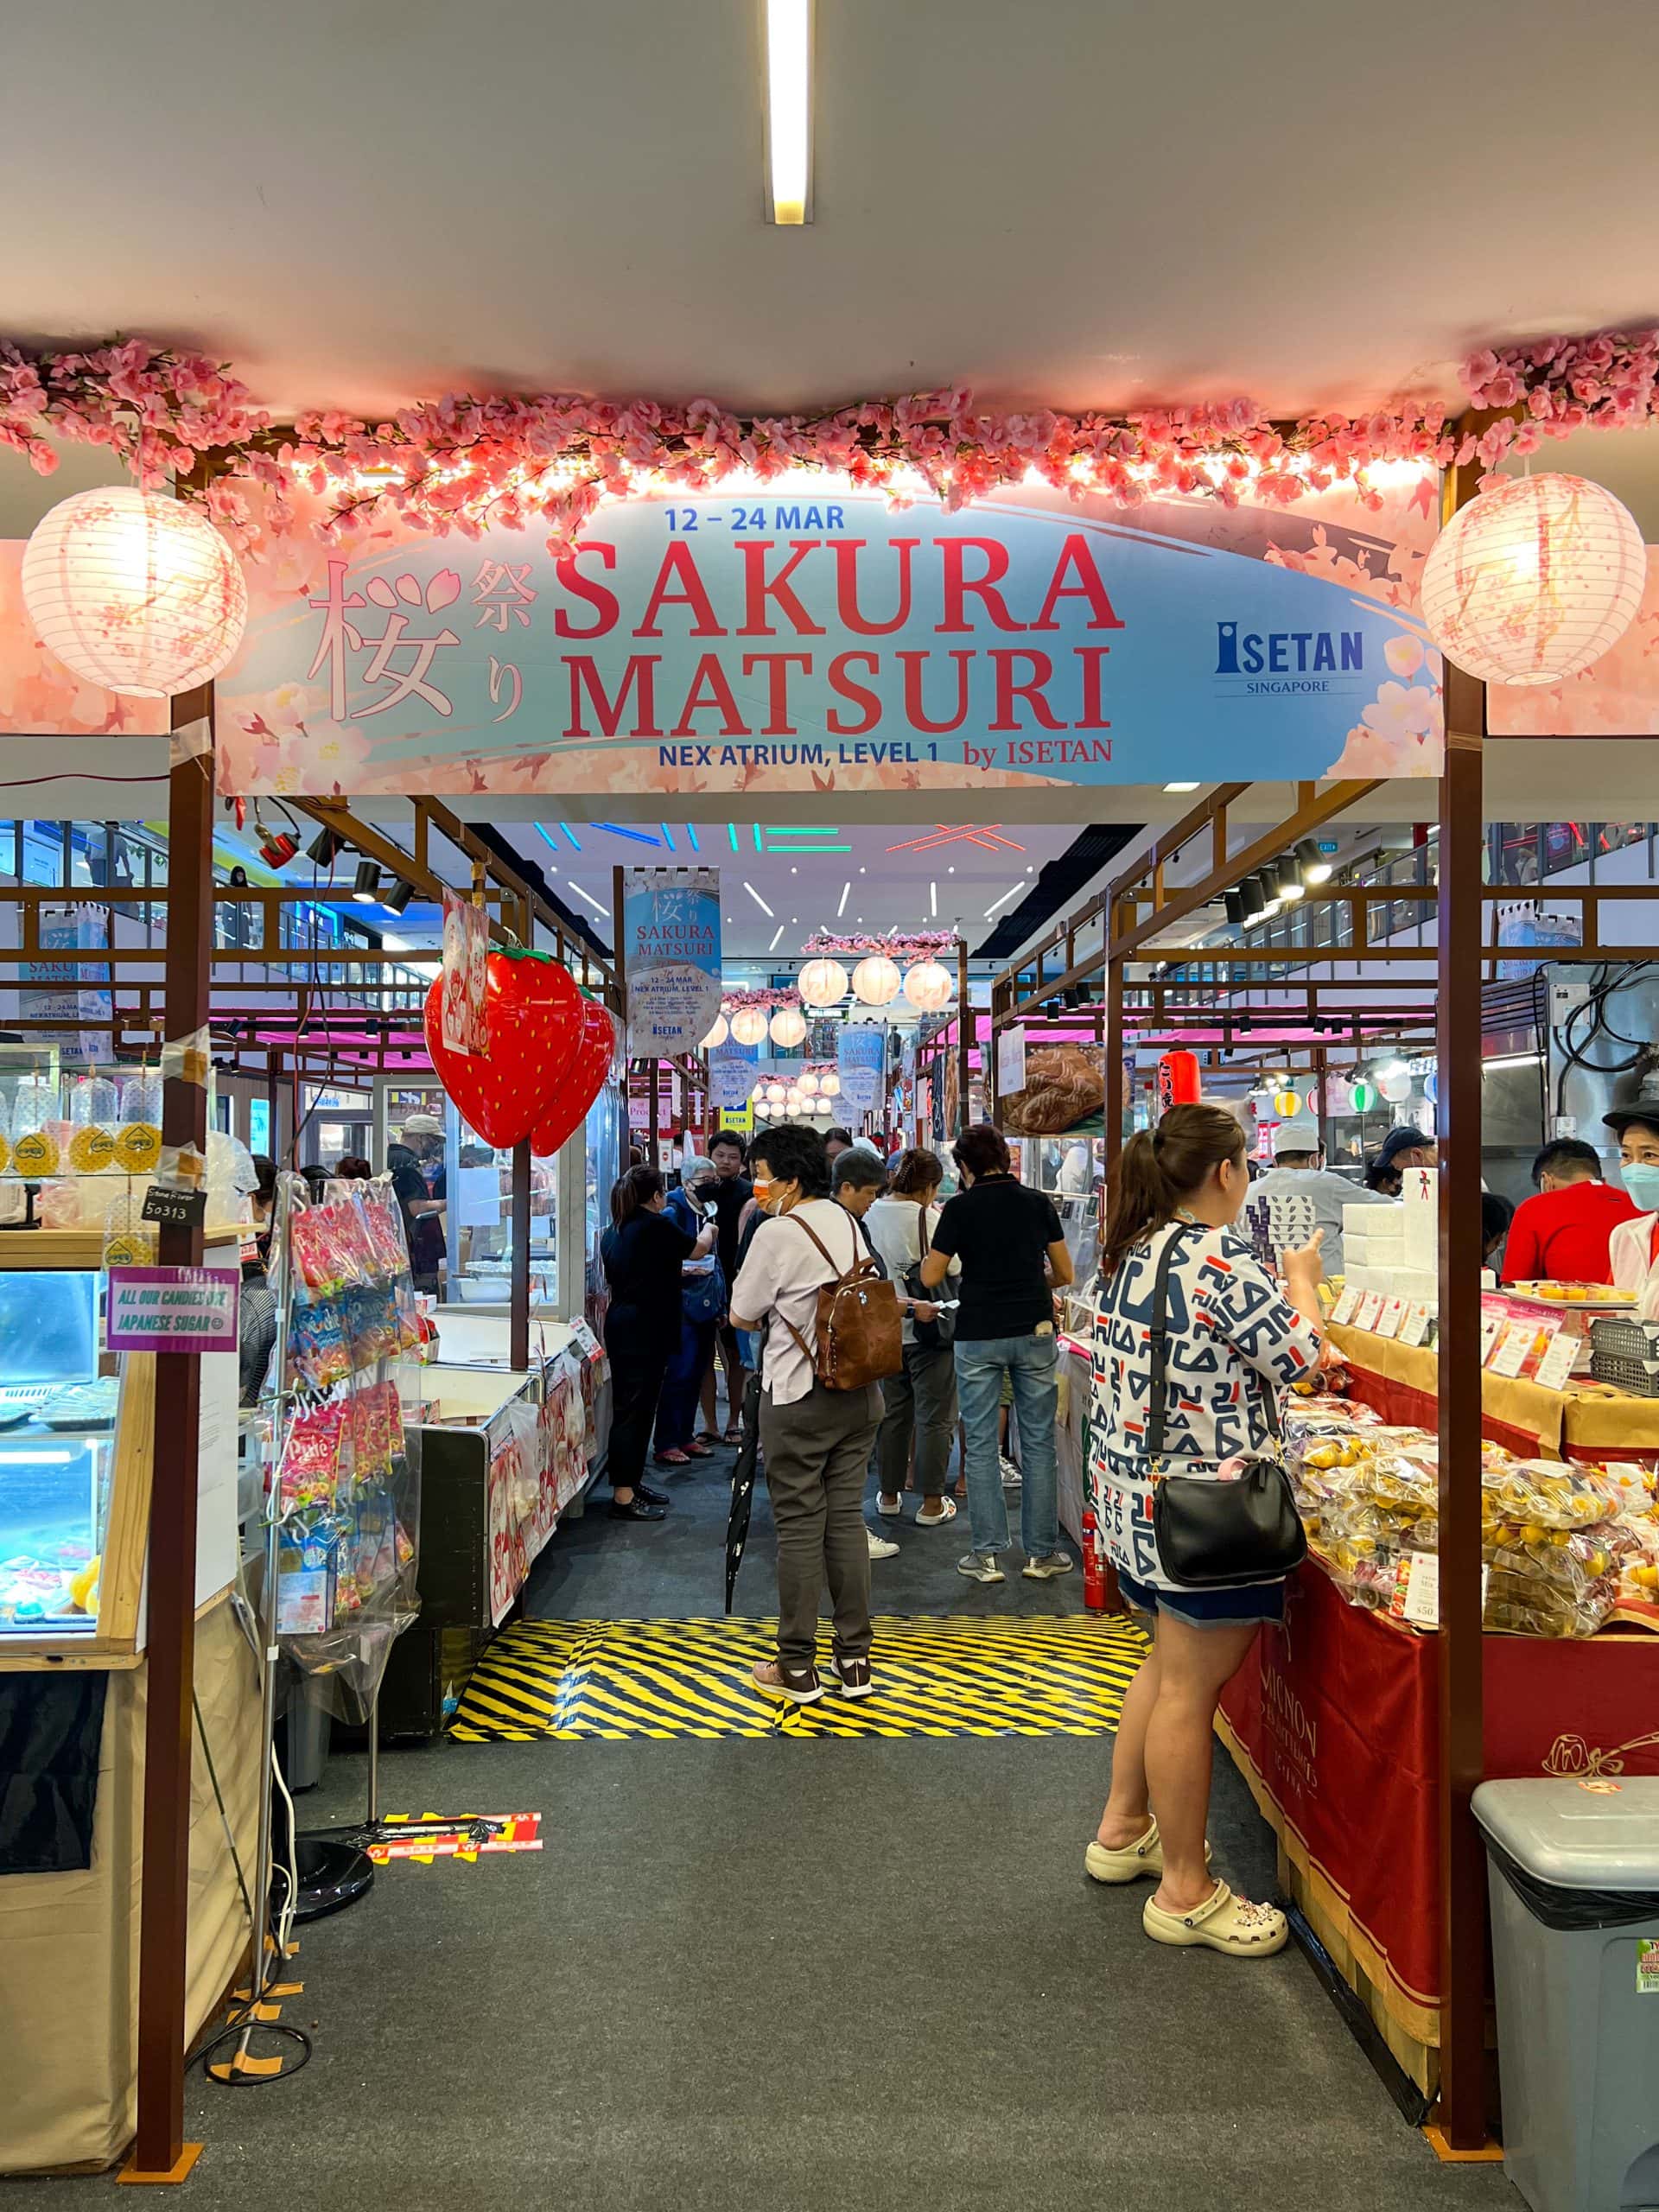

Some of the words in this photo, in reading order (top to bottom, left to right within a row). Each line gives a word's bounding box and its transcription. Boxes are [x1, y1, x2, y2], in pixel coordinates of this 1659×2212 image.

[664, 507, 698, 531] 12
[731, 505, 767, 531] 24
[775, 505, 845, 530] MAR
[554, 533, 1125, 640] SAKURA
[1214, 621, 1363, 674] ISETAN
[562, 646, 1112, 738] MATSURI
[1246, 680, 1331, 694] SINGAPORE
[658, 745, 712, 767] NEX
[720, 743, 831, 769] ATRIUM,
[838, 741, 918, 765] LEVEL
[929, 741, 938, 764] 1
[963, 741, 997, 772] by
[1007, 739, 1113, 764] ISETAN
[637, 925, 715, 940] SAKURA
[638, 943, 713, 956] MATSURI
[145, 1202, 187, 1220] 50313
[118, 1289, 137, 1305] ALL
[138, 1290, 161, 1305] OUR
[161, 1290, 205, 1306] CANDIES
[118, 1314, 173, 1331] JAPANESE
[174, 1314, 211, 1332] SUGAR
